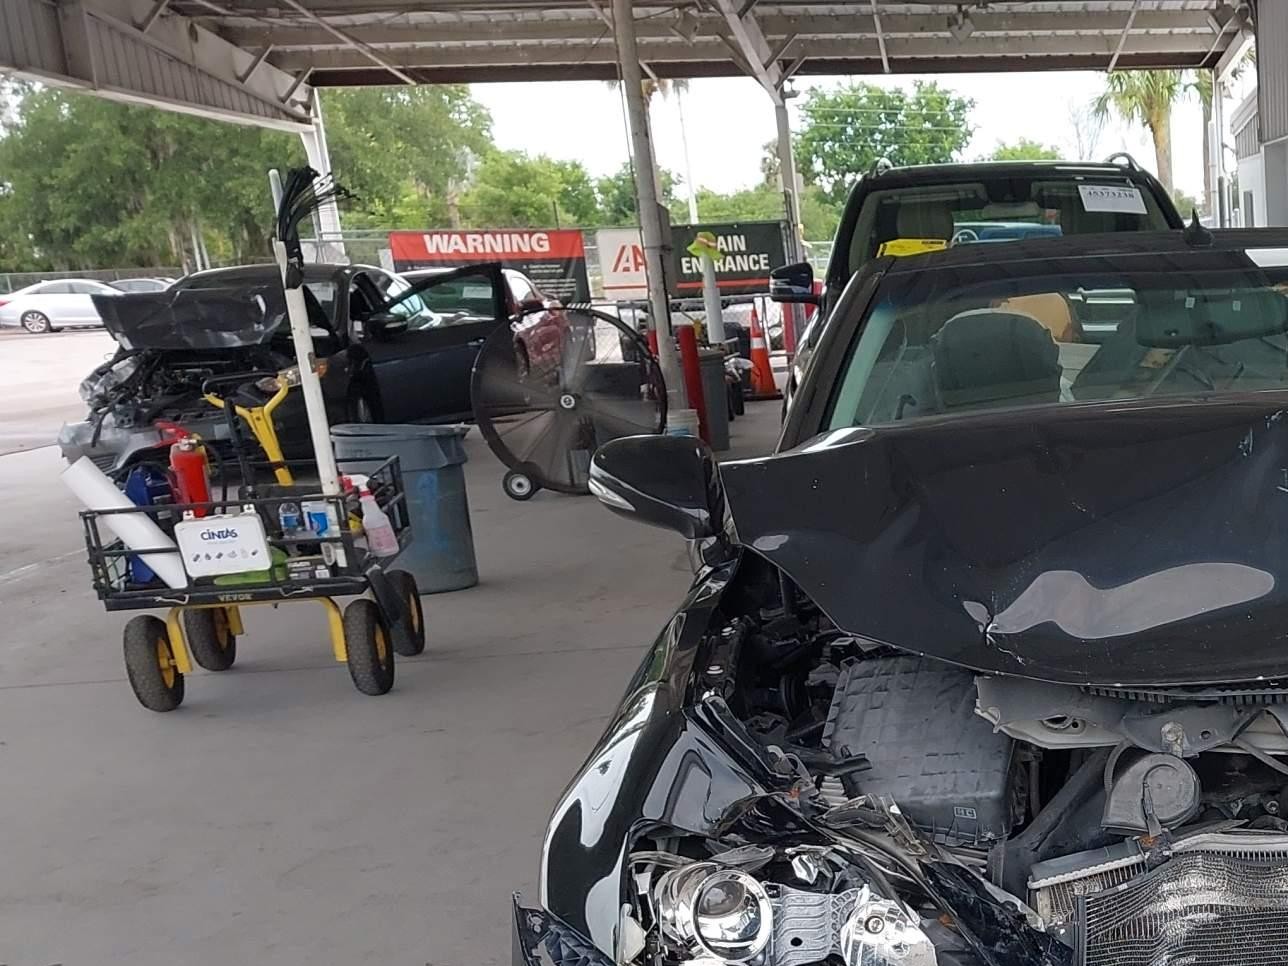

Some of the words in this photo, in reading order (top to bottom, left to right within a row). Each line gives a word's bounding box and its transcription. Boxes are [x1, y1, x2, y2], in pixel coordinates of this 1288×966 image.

[423, 233, 550, 253] WARNING
[716, 235, 747, 252] AIN
[681, 254, 770, 274] ENRANCE
[200, 528, 238, 541] CINTAS
